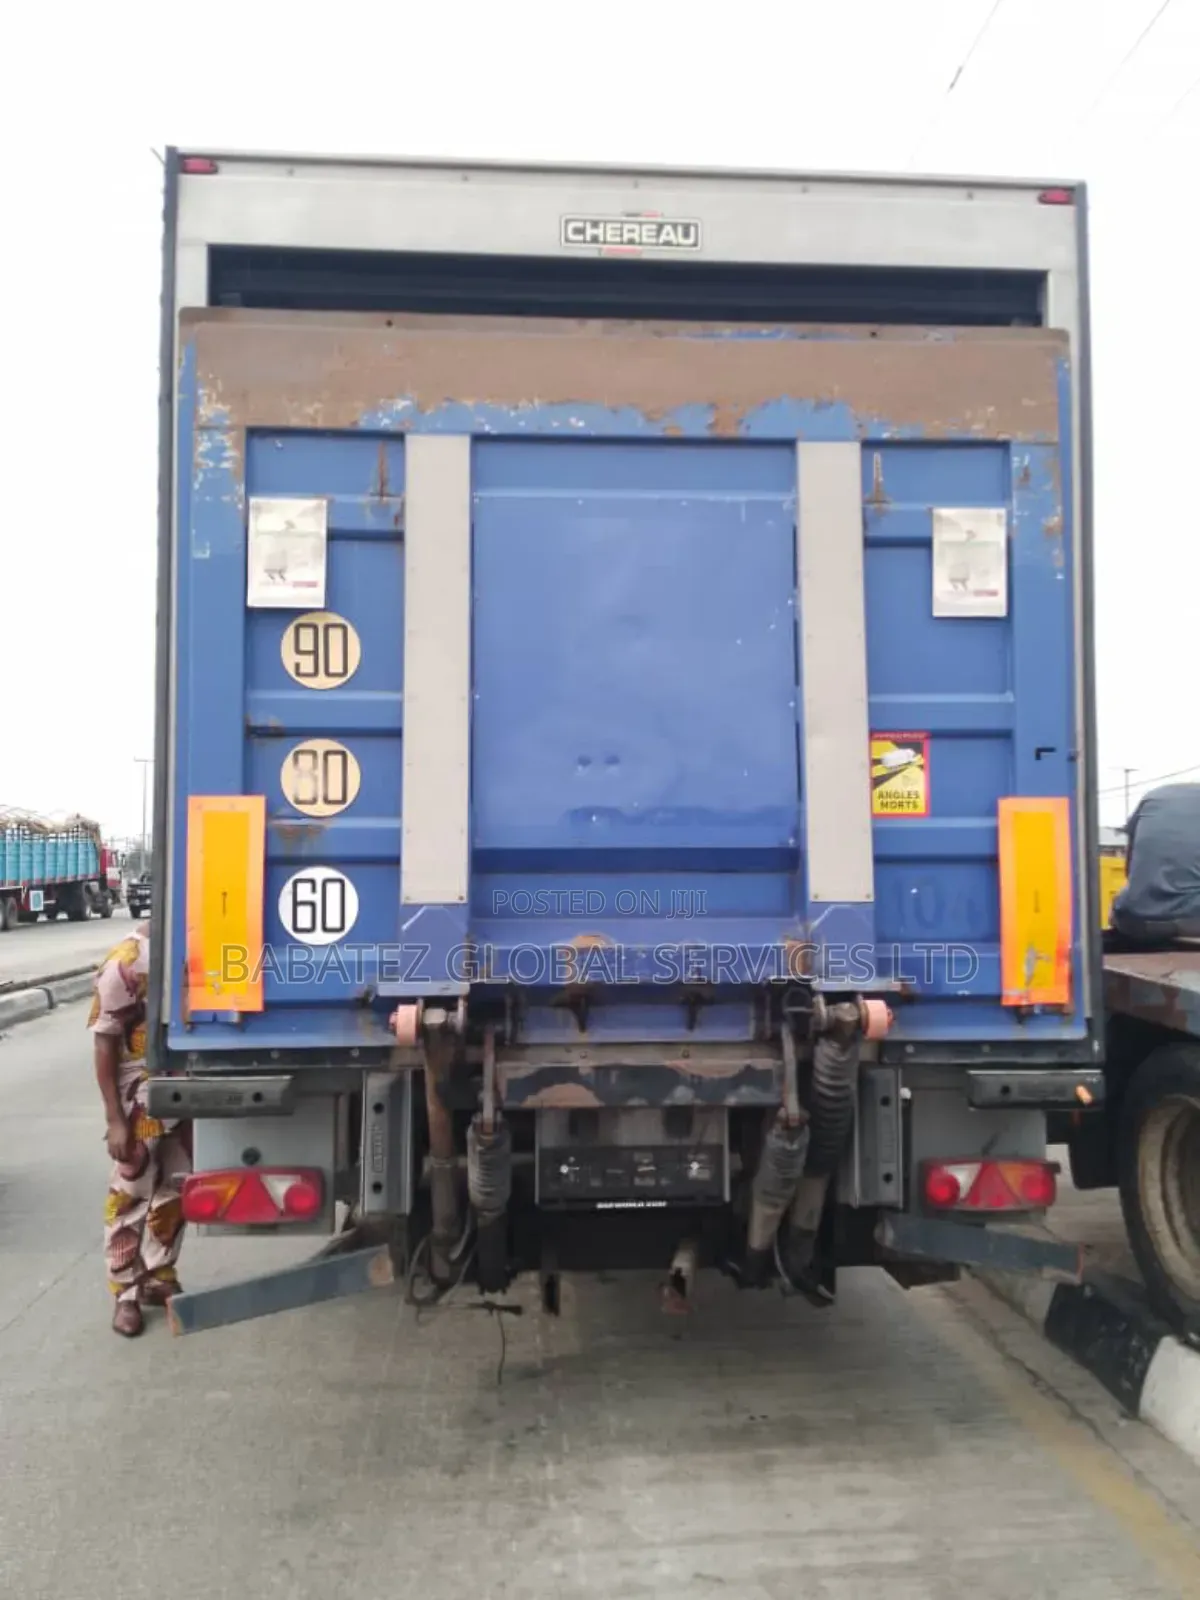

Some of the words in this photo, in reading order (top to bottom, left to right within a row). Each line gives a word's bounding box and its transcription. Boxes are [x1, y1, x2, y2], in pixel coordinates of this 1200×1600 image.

[566, 221, 697, 245] CHEREAU
[294, 622, 349, 678] 90
[878, 790, 920, 800] ANGLES
[880, 801, 919, 810] MORTS
[291, 877, 346, 933] 60
